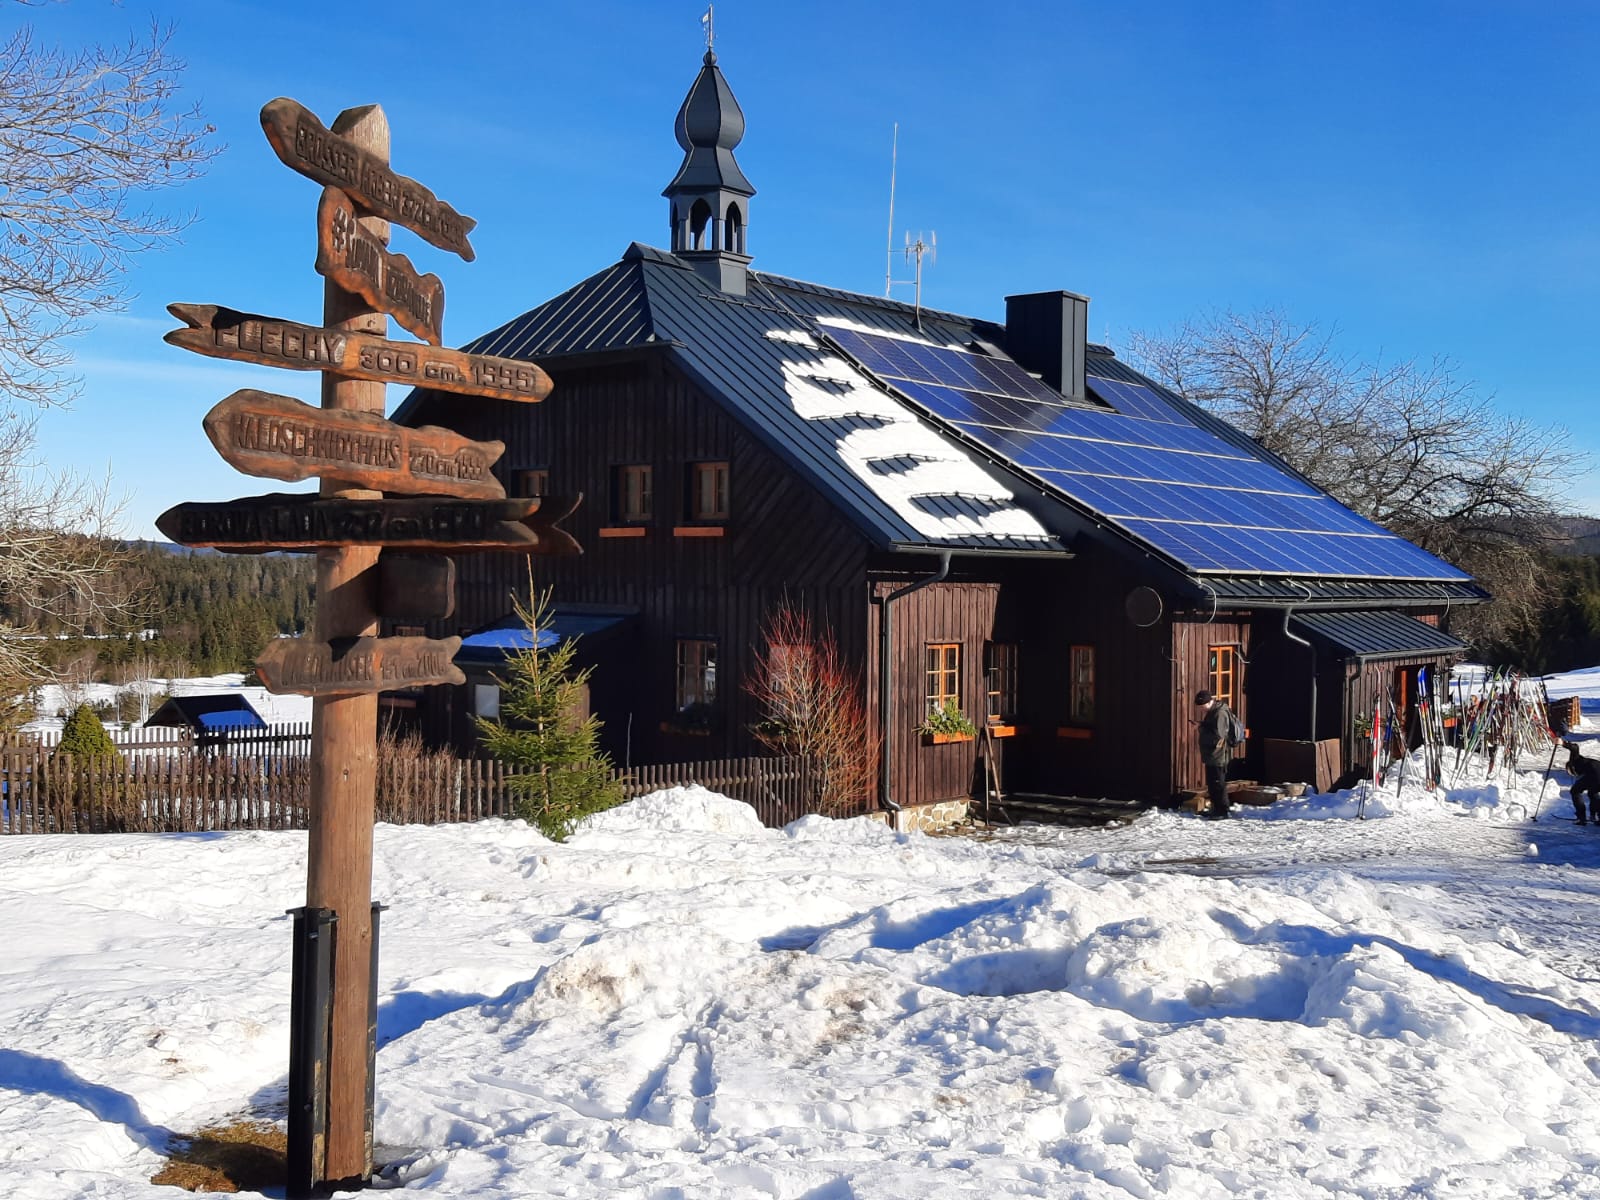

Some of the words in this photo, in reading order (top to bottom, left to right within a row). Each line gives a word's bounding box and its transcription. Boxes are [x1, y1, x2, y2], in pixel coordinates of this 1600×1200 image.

[296, 121, 361, 185] GROSSER
[361, 160, 401, 209] ARBER
[360, 350, 416, 376] 300
[471, 362, 535, 393] 1999
[232, 412, 399, 468] WALDSCHMIDTHAUS
